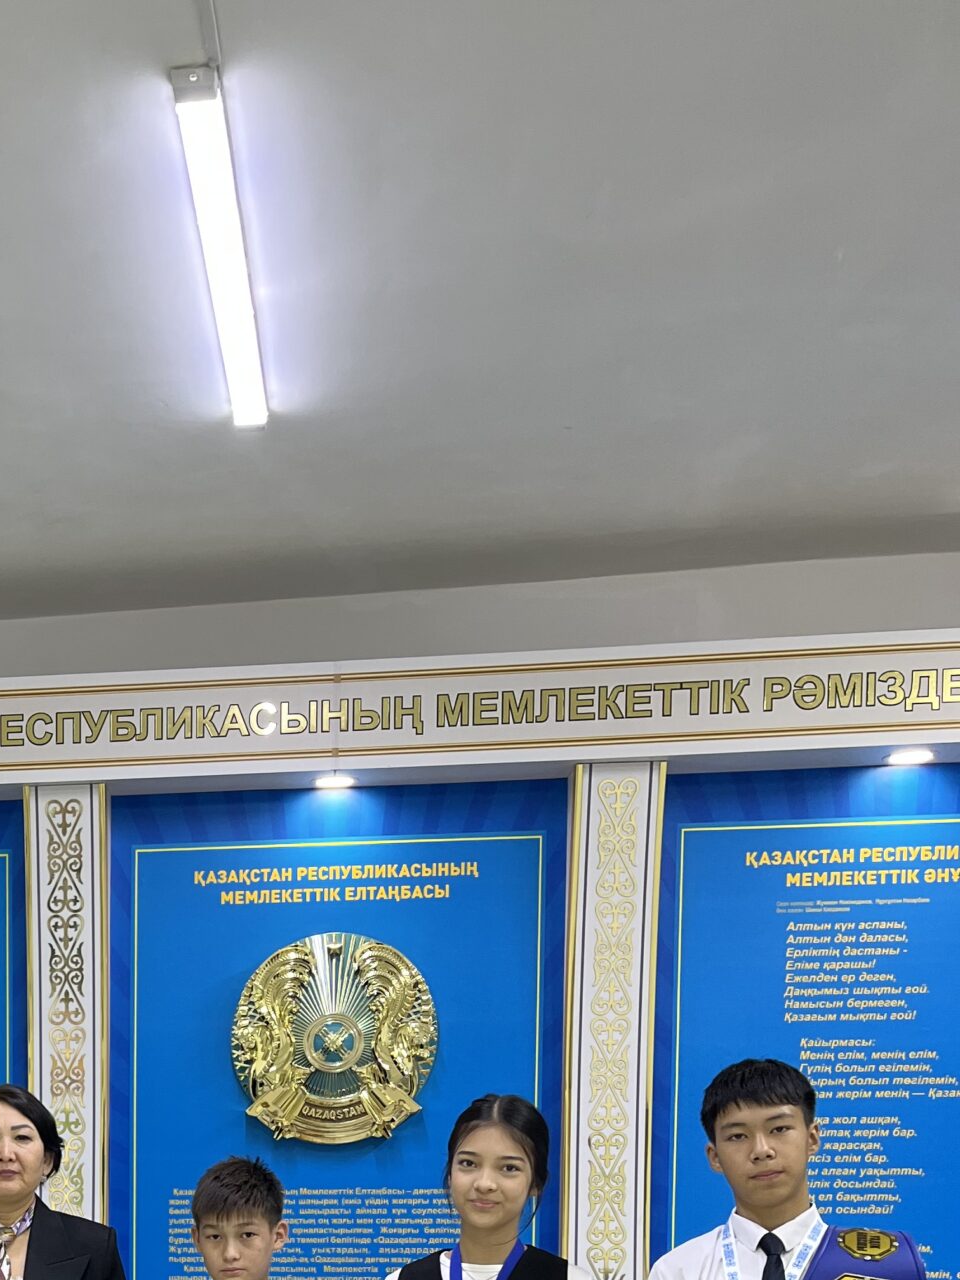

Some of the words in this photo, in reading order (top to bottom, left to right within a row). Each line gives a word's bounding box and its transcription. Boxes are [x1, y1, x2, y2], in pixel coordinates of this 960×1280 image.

[437, 678, 750, 728] МЕМЛЕКЕТТІК
[746, 849, 854, 868] ҚАЗАҚСТАН
[860, 845, 960, 863] РЕСПУБЛИ
[194, 868, 292, 886] ҚАЗАҚСТАН
[297, 862, 479, 881] РЕСПУБЛИКАСЫНЫҢ
[786, 870, 920, 887] МЕМЛЕКЕТТІК
[220, 888, 340, 904] МЕМЛЕКЕТТІК
[345, 884, 450, 902] ЕЛТАҢБАСЫ
[786, 922, 831, 931] Алтын
[834, 922, 855, 932] күн
[786, 935, 831, 944] Алтын
[834, 934, 855, 943] дән
[859, 933, 908, 942] даласы,
[785, 948, 840, 958] Ерліктің
[843, 947, 900, 956] дастаны
[785, 961, 820, 970] Еліме
[823, 960, 876, 971] қарашы!
[785, 973, 838, 983] Ежелден
[841, 975, 855, 984] ер
[859, 973, 896, 982] деген,
[783, 987, 849, 997] Даңқымыз
[853, 987, 902, 996] шықты
[784, 999, 843, 1008] Намысын
[847, 998, 908, 1009] бермеген,
[840, 1012, 887, 1022] мықты
[800, 1038, 875, 1048] Қайырмасы:
[800, 1051, 834, 1060] Менің
[838, 1050, 867, 1060] елім,
[871, 1050, 906, 1060] менің
[909, 1050, 939, 1060] елім,
[835, 1063, 875, 1072] болып
[810, 1077, 846, 1086] ырың
[849, 1076, 889, 1085] болып
[836, 1089, 871, 1100] жерім
[875, 1089, 909, 1099] менің
[302, 1104, 366, 1120] QAZAQSTAN
[833, 1116, 856, 1124] жол
[860, 1116, 901, 1125] ашқан,
[853, 1128, 889, 1138] жерім
[892, 1128, 917, 1138] бар.
[823, 1142, 883, 1151] жарасқан,
[834, 1154, 861, 1162] елім
[864, 1153, 889, 1163] бар.
[860, 1167, 925, 1177] уақытты,
[833, 1179, 897, 1188] досындай.
[818, 1193, 832, 1201] ел
[836, 1192, 902, 1202] бақытты,
[836, 1205, 893, 1214] осындай!
